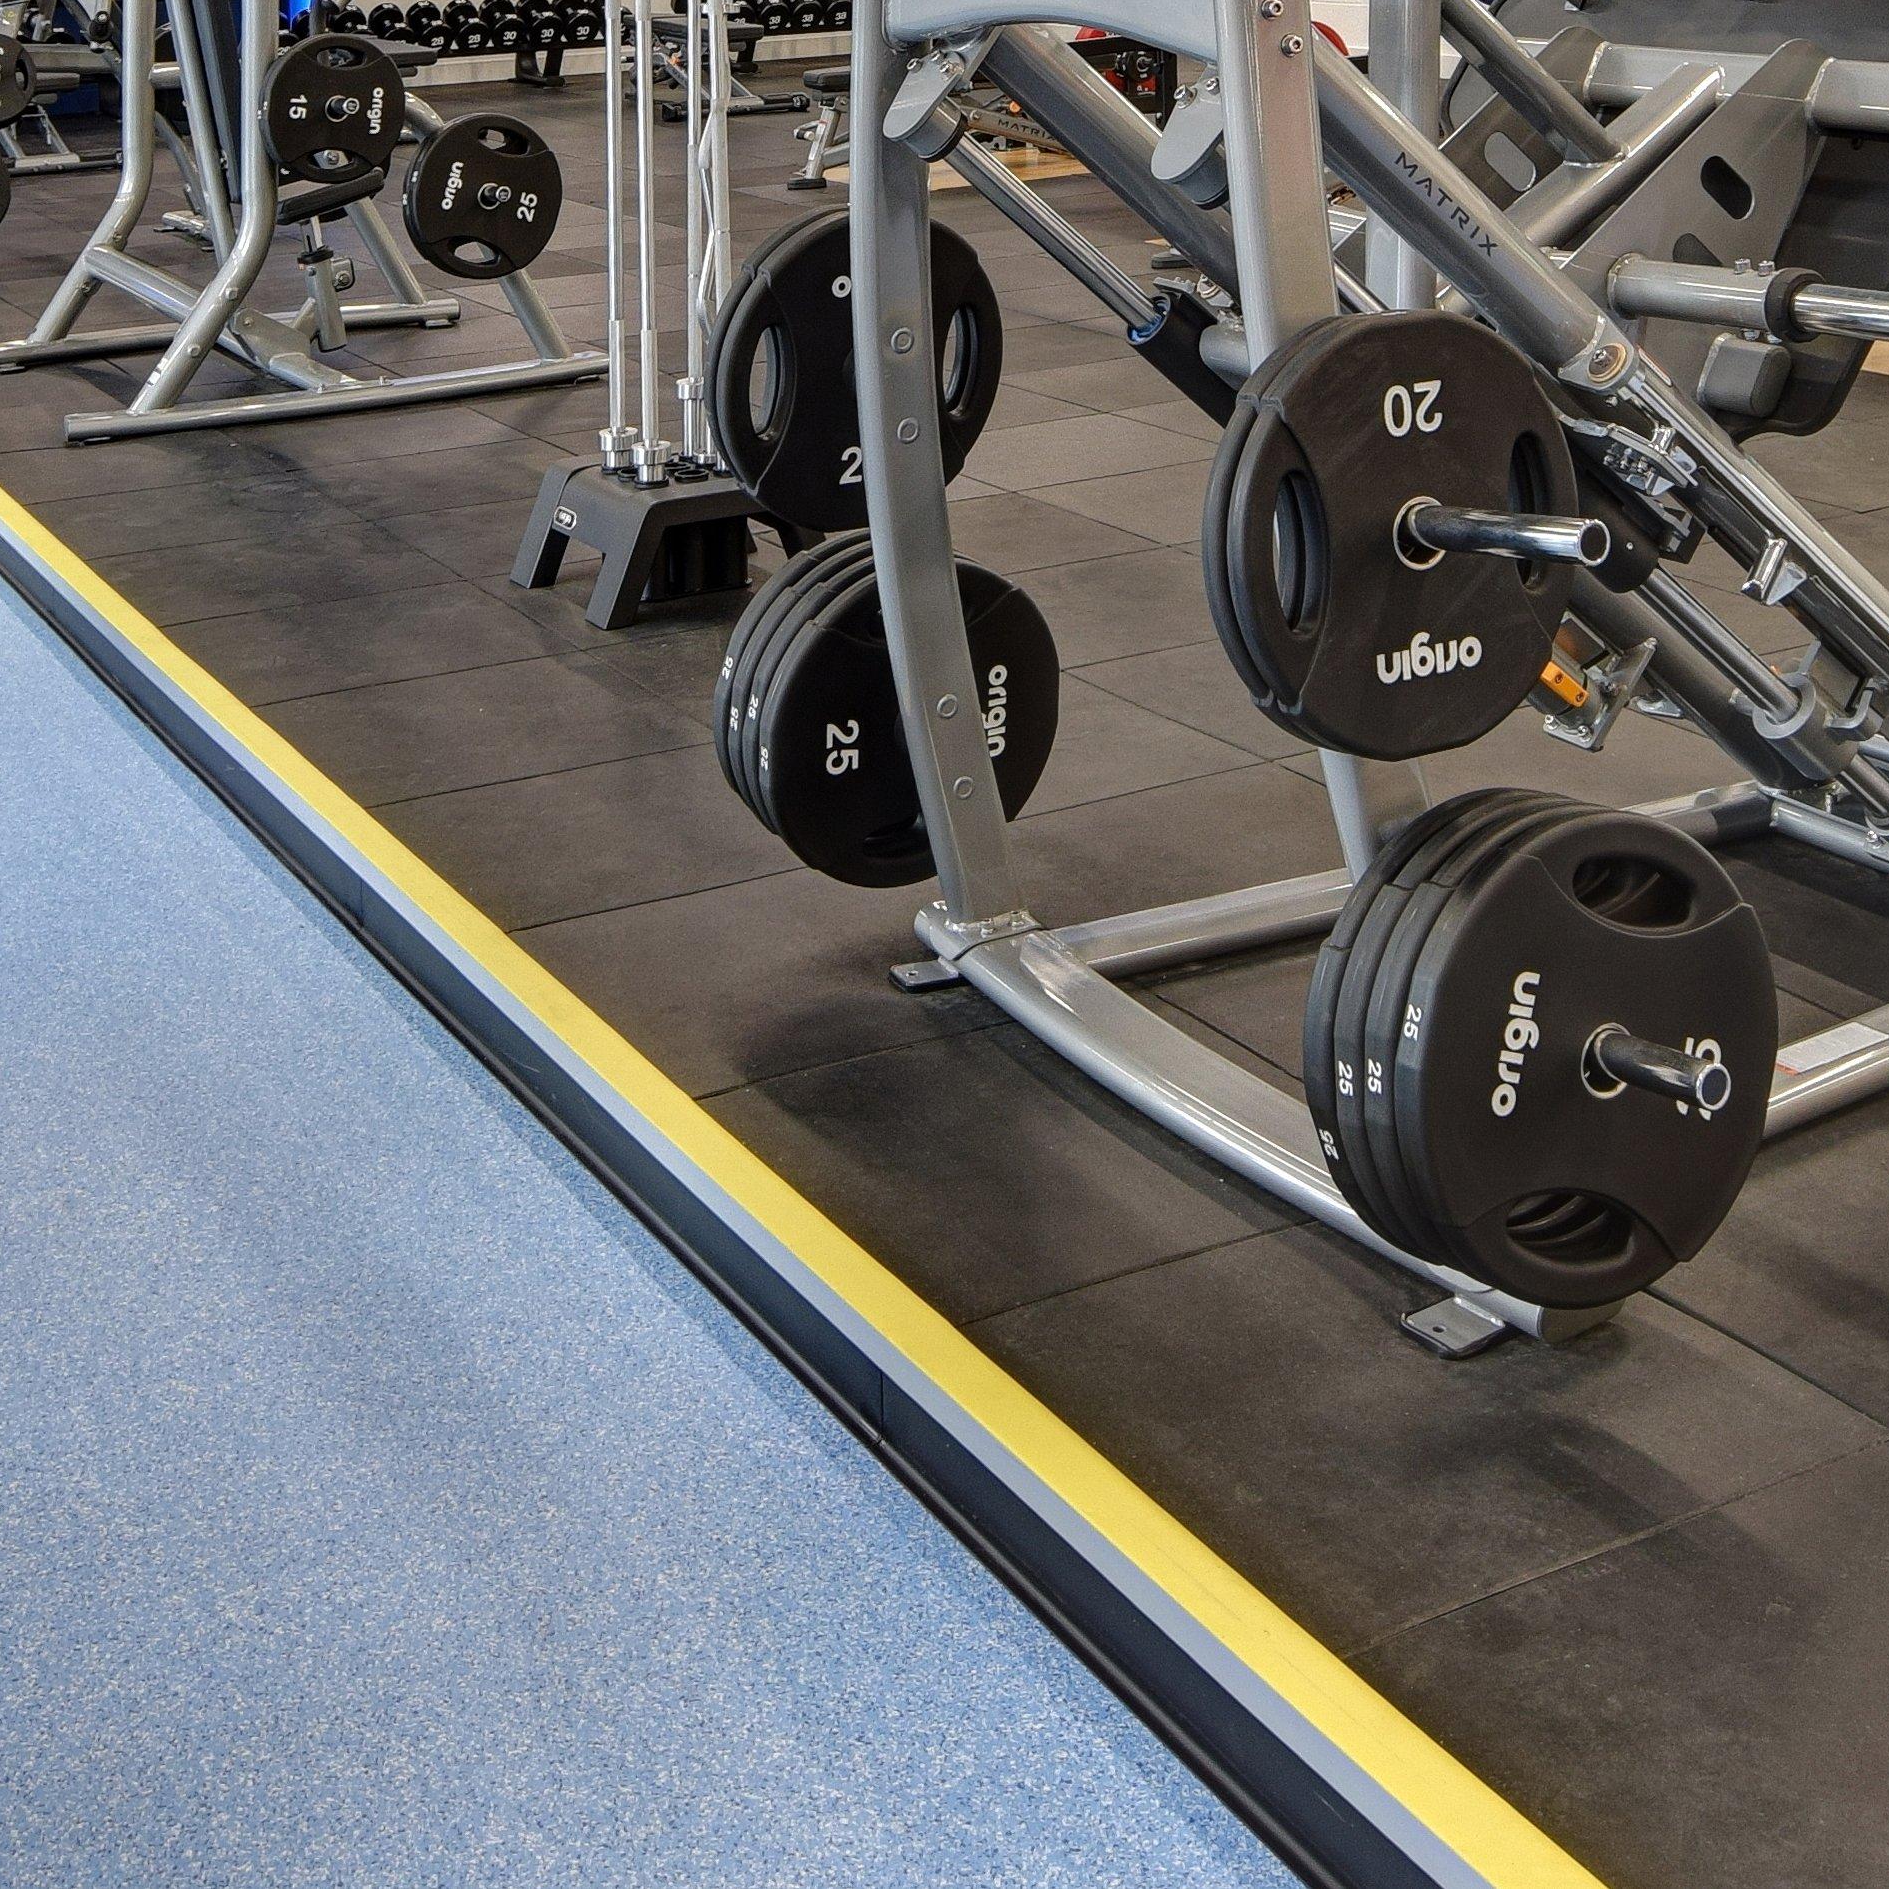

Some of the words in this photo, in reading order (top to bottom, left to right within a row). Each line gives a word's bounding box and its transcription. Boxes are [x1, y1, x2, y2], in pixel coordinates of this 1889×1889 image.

[288, 94, 308, 120] 15
[366, 86, 385, 135] origin
[441, 160, 465, 211] origin
[516, 191, 539, 223] 25
[1394, 150, 1499, 259] MATRIX
[1383, 379, 1443, 439] 20
[839, 446, 863, 486] 2
[1376, 631, 1484, 685] origin
[825, 719, 860, 775] 25
[1403, 1003, 1422, 1042] 25
[1491, 971, 1541, 1118] origin
[1338, 1060, 1354, 1097] 25
[1367, 1058, 1382, 1096] 25
[1319, 1128, 1340, 1162] 25
